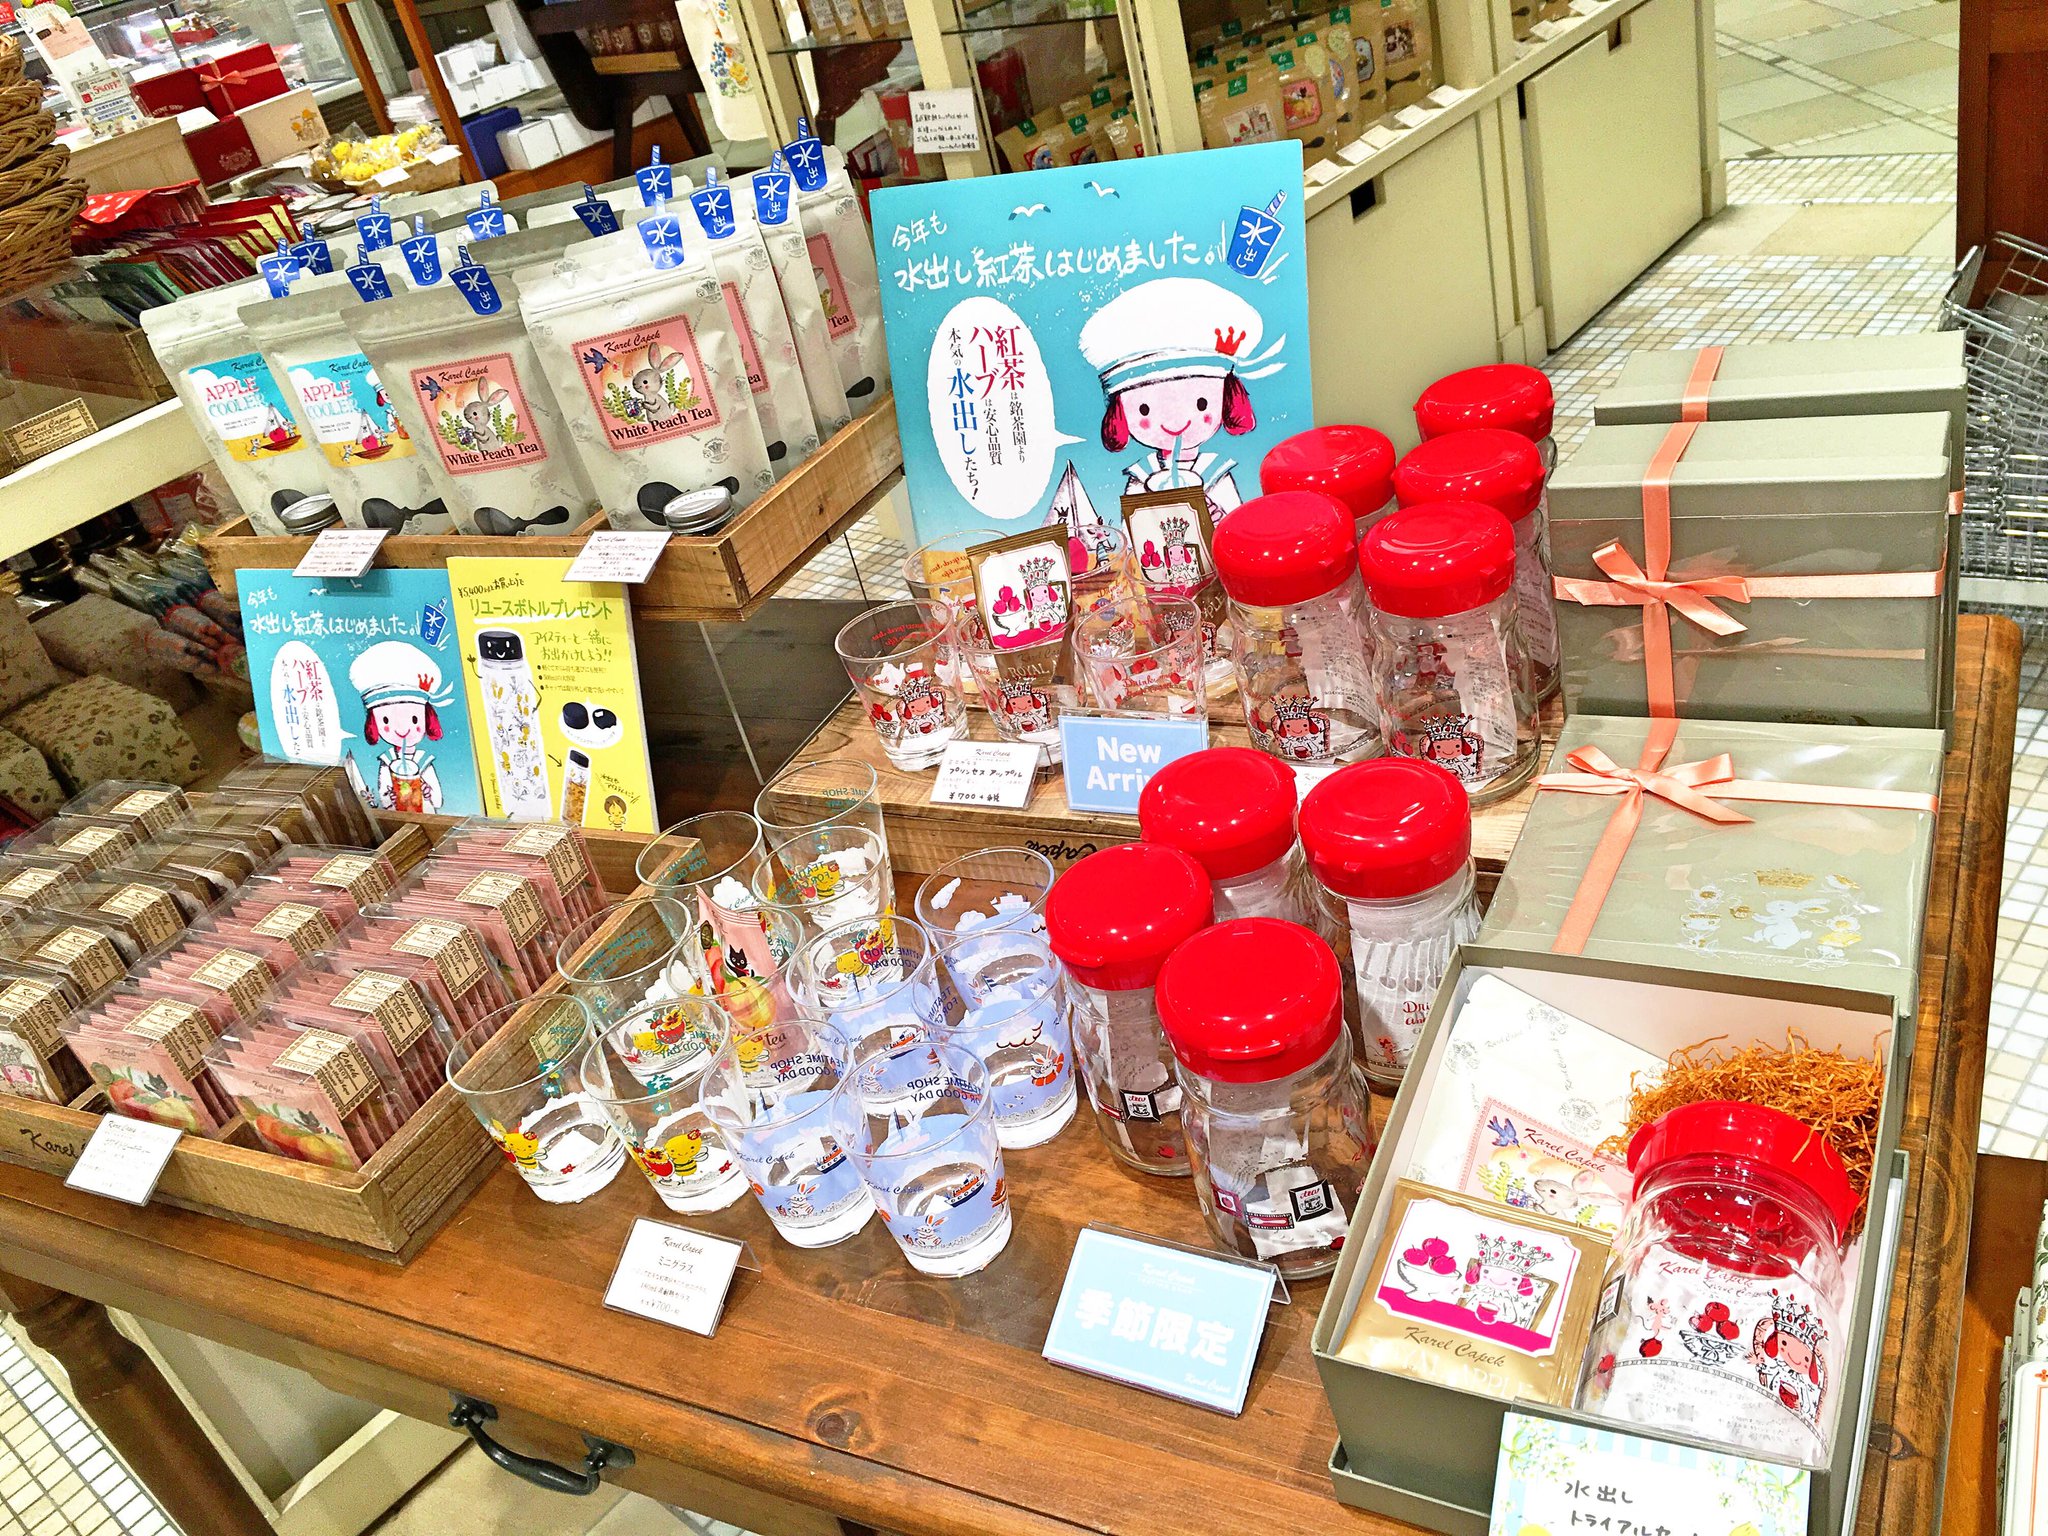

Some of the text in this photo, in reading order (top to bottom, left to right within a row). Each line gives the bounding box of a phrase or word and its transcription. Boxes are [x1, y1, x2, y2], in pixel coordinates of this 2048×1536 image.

[891, 210, 948, 252] 今年も
[603, 339, 631, 354] Karel
[205, 376, 259, 402] APPLE
[303, 379, 353, 403] APPLE
[747, 373, 762, 384] ea
[209, 393, 268, 418] COOLER
[969, 326, 1003, 466] ハーブは安心品質
[994, 325, 1027, 464] 紅茶は銘茶園より
[305, 397, 362, 419] COOLER
[611, 423, 648, 441] White
[651, 413, 688, 433] Peach
[688, 406, 713, 421] Tea
[446, 453, 480, 466] White
[481, 446, 515, 461] Peach
[515, 442, 539, 455] Tea
[1096, 735, 1162, 764] New
[765, 1032, 788, 1046] tea
[1524, 1128, 1561, 1154] Karel
[658, 1256, 694, 1274] ミニグラス
[1074, 1287, 1236, 1367] 季節限定
[1404, 1326, 1452, 1351] Karel
[1564, 1480, 1634, 1505] 水出し
